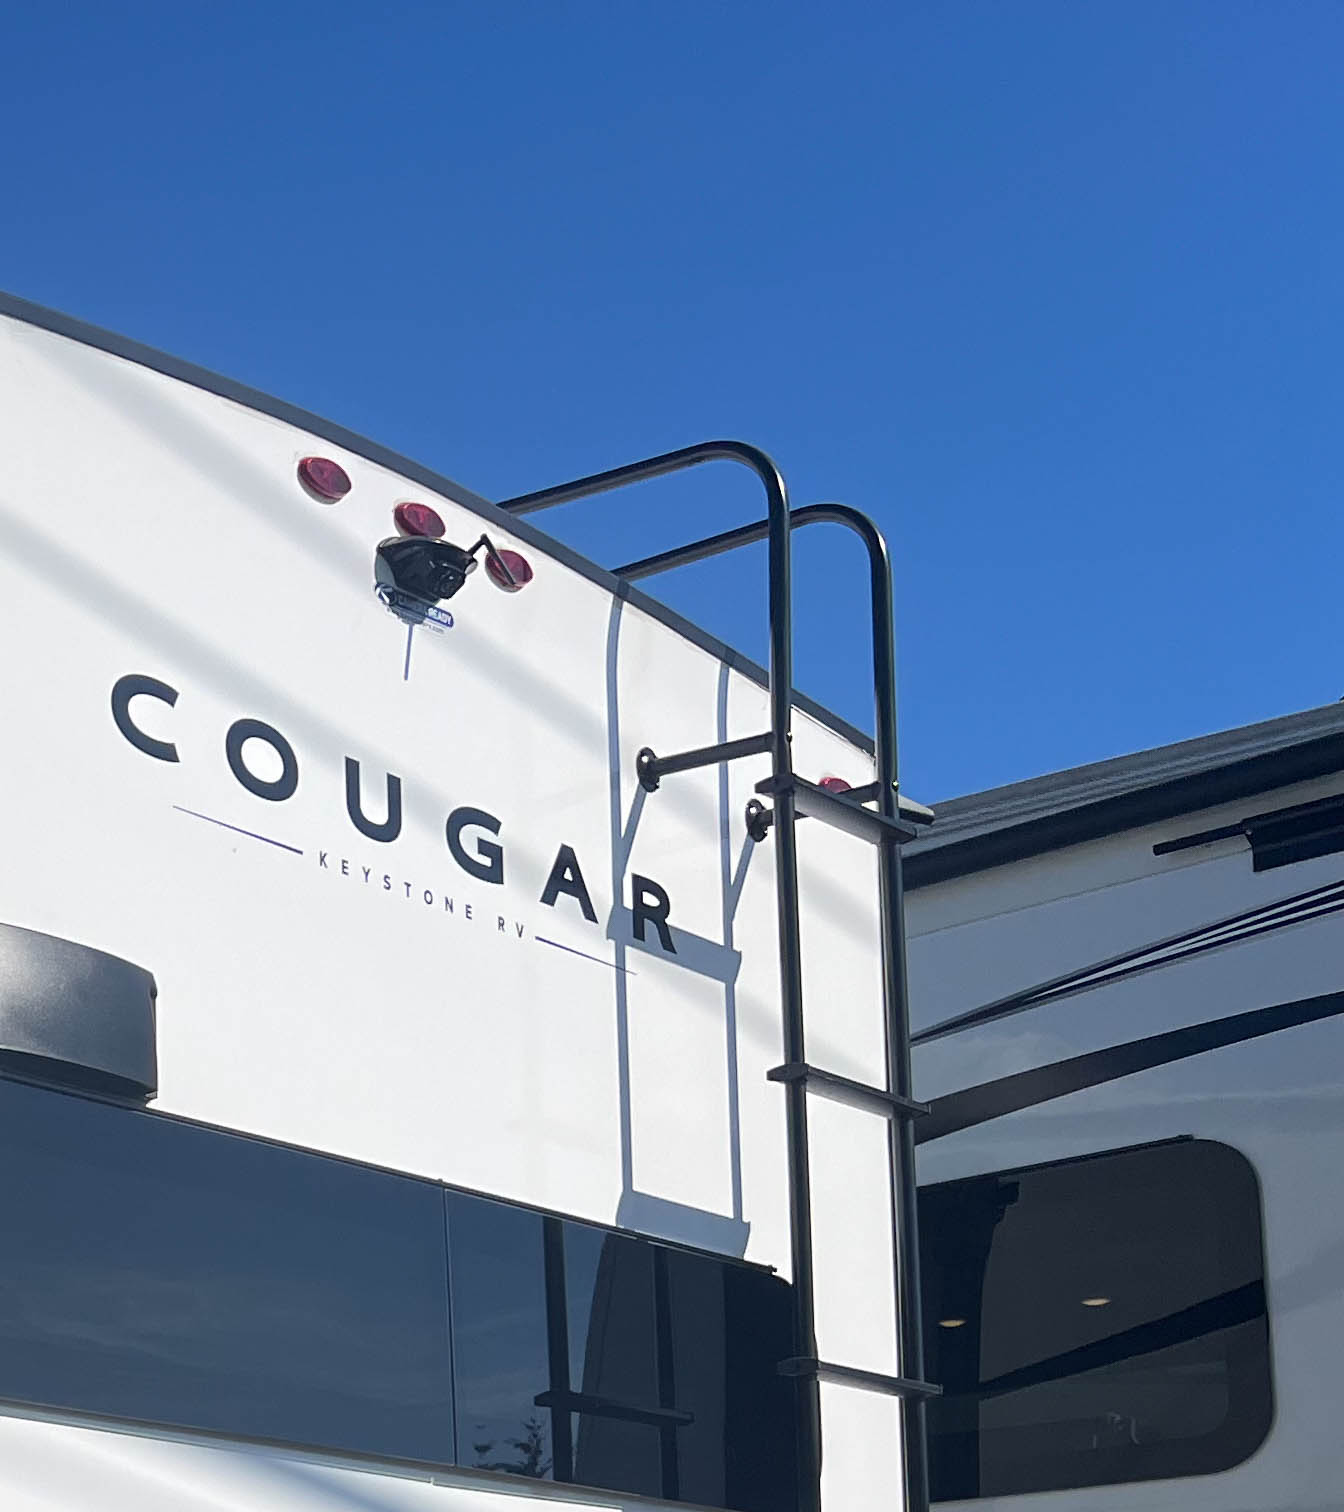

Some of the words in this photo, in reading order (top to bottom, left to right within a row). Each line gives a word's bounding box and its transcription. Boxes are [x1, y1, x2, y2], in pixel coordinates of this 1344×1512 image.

[111, 673, 677, 955] COUGAR
[318, 850, 474, 922] KEYSTONE
[497, 915, 526, 939] RV
